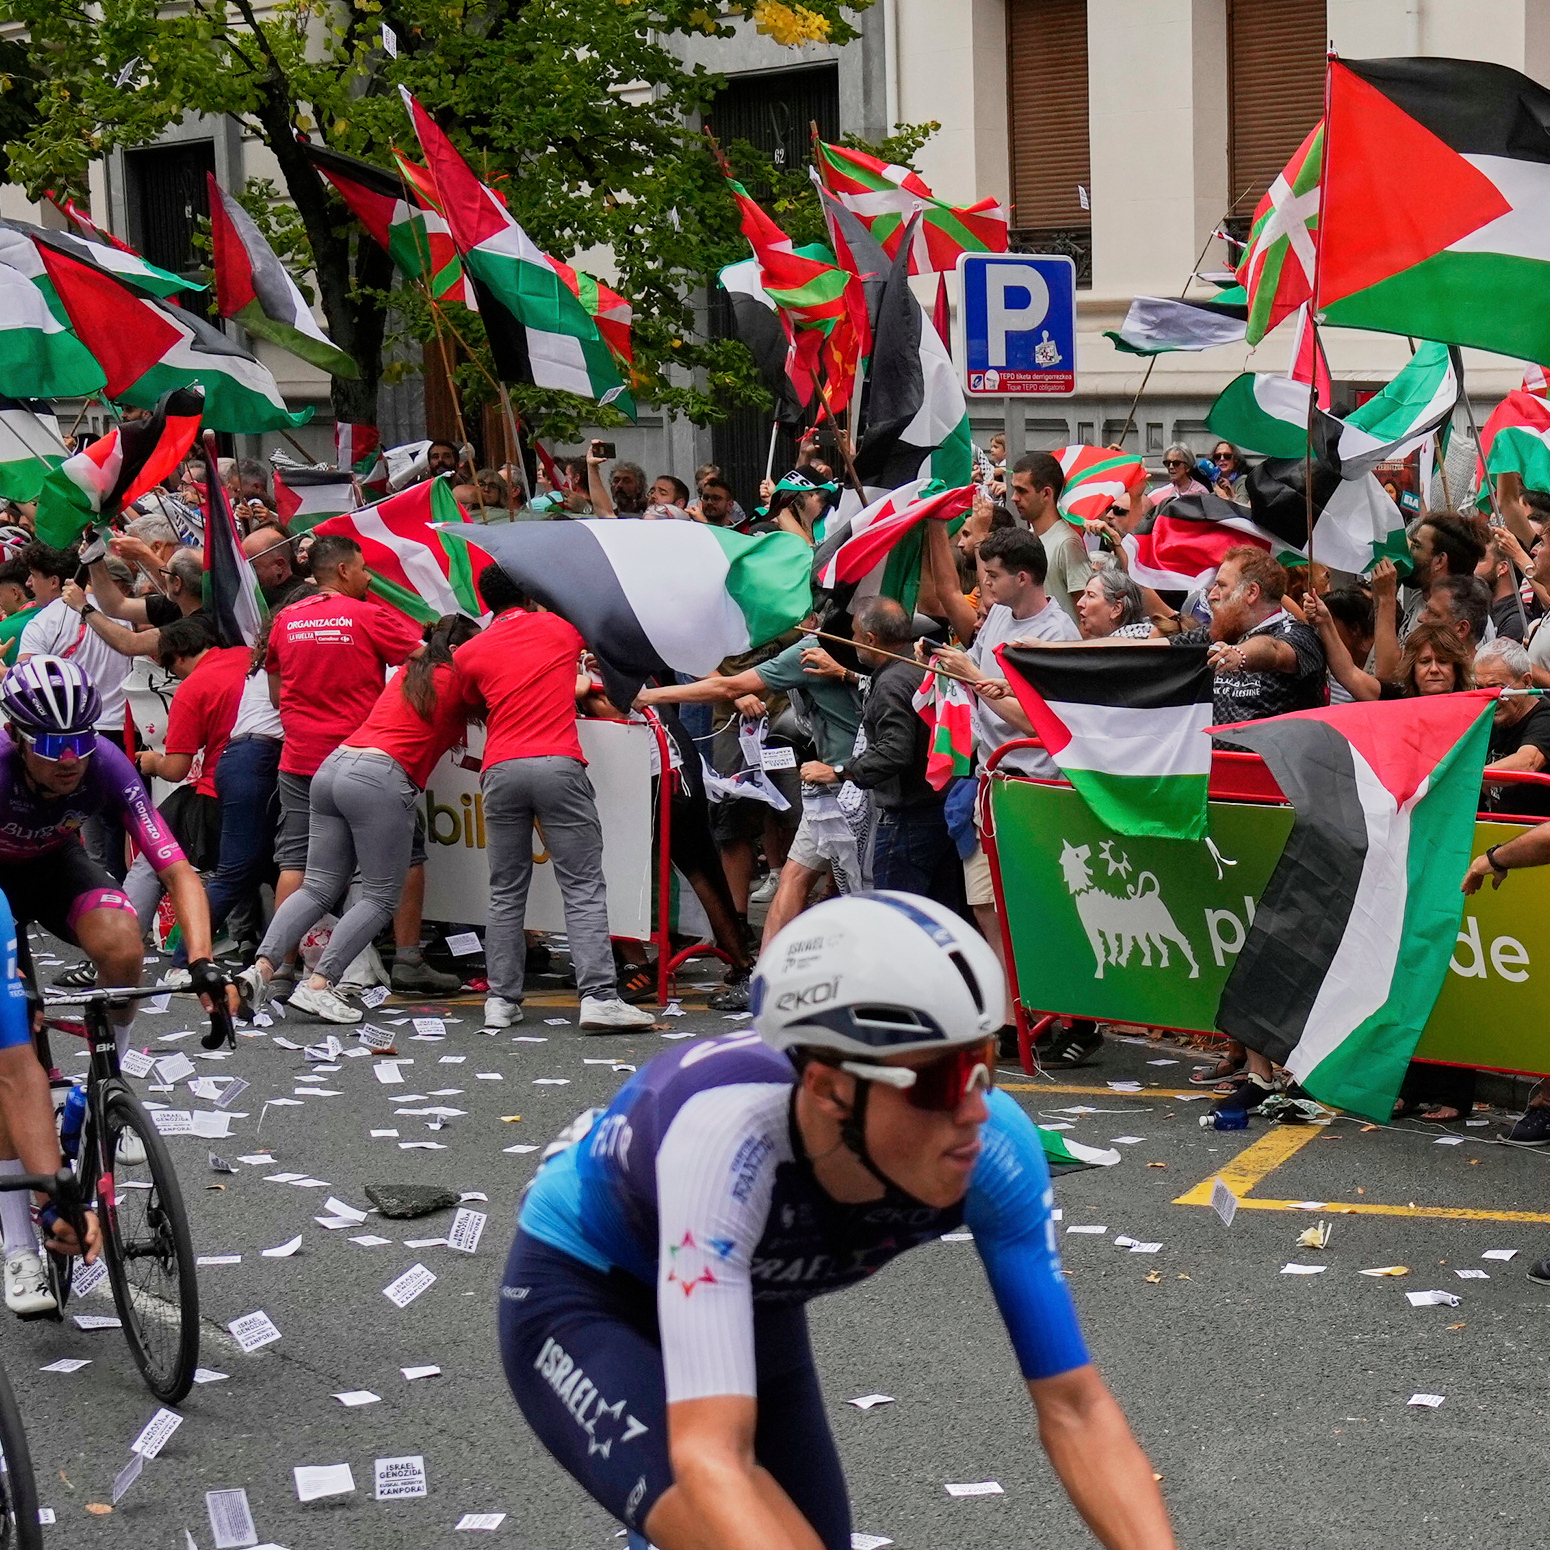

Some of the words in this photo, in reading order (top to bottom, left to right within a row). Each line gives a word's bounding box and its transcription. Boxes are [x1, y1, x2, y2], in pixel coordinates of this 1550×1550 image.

[774, 148, 785, 164] 62
[986, 263, 1050, 367] P
[287, 616, 353, 631] ORGANIZACIÓN
[96, 1042, 116, 1053] BH
[533, 1336, 599, 1427] ISRAEL
[386, 1462, 416, 1471] ISRAEL
[379, 1469, 422, 1479] GENOZIDA
[380, 1485, 425, 1496] KANPORA!
